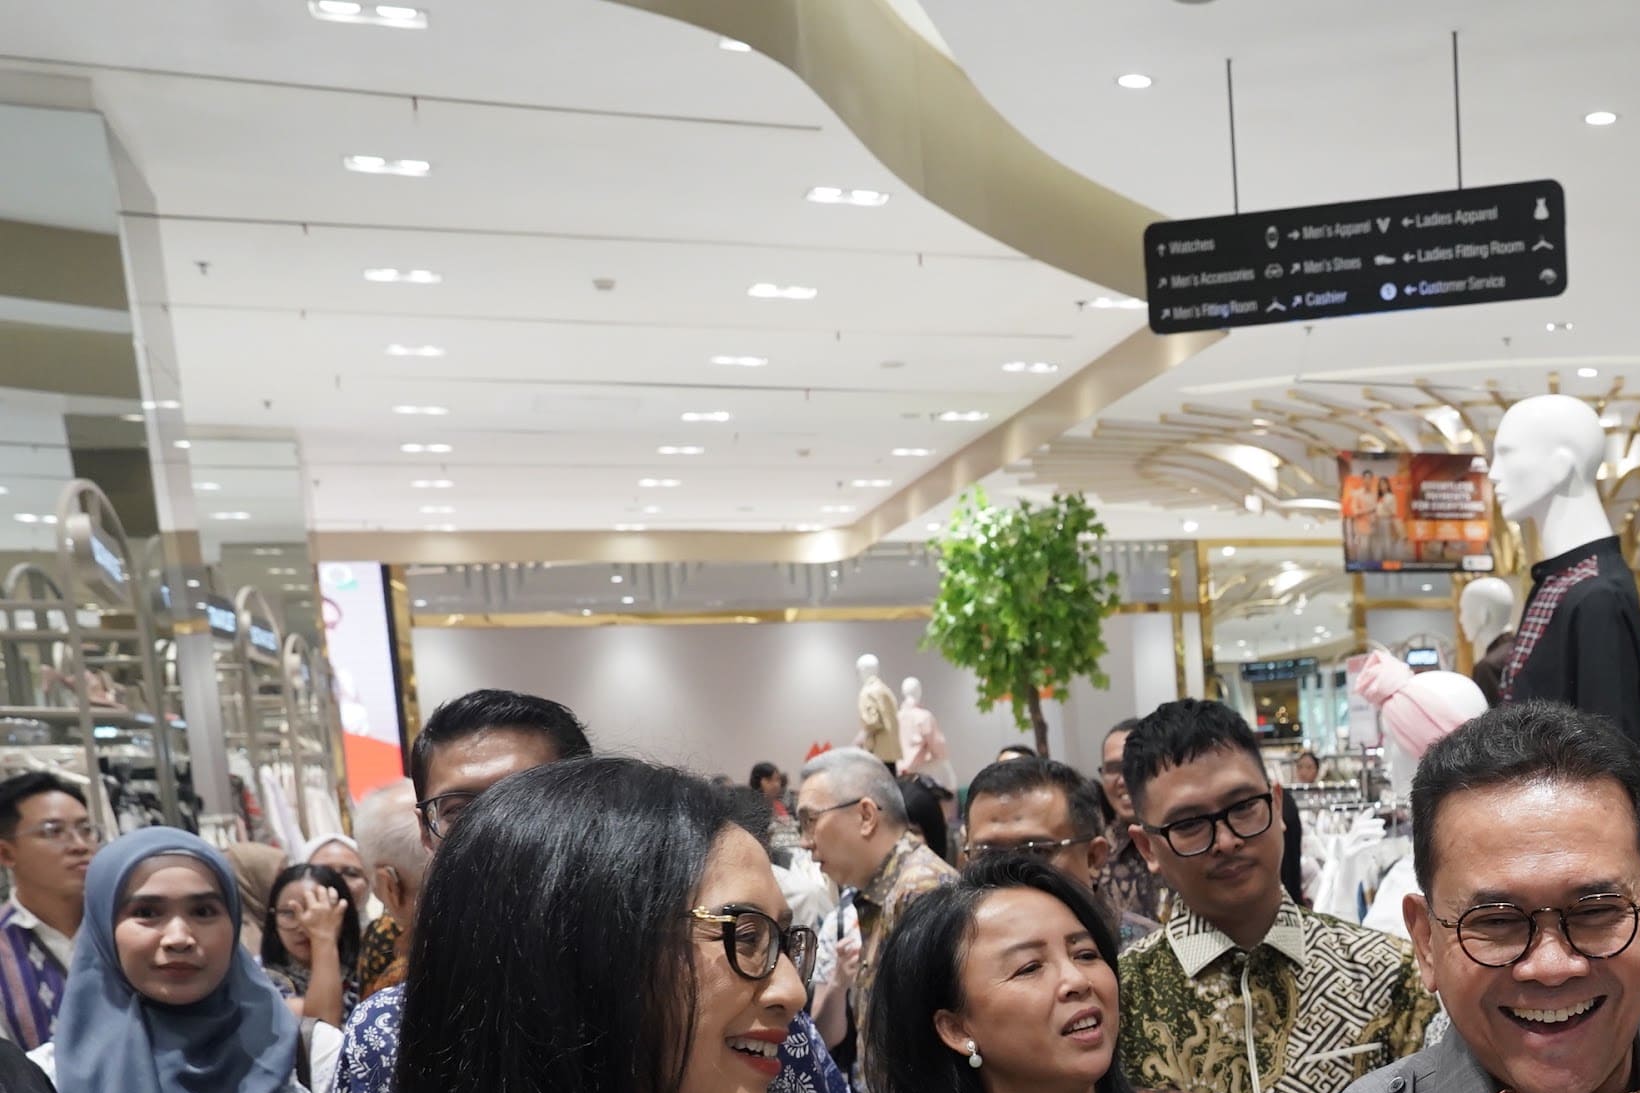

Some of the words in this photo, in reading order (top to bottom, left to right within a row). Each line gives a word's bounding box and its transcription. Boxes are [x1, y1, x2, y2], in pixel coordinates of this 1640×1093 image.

[1416, 213, 1453, 228] Ladies
[1455, 205, 1498, 225] Apparel
[1302, 225, 1333, 240] Men's
[1334, 220, 1372, 238] Apparel
[1417, 248, 1454, 263] Ladies
[1455, 244, 1489, 260] Fitting
[1490, 240, 1525, 255] Room
[1303, 260, 1332, 273] Men's
[1419, 280, 1467, 295] Customer
[1468, 275, 1506, 290] Service
[1305, 290, 1347, 306] Cashier
